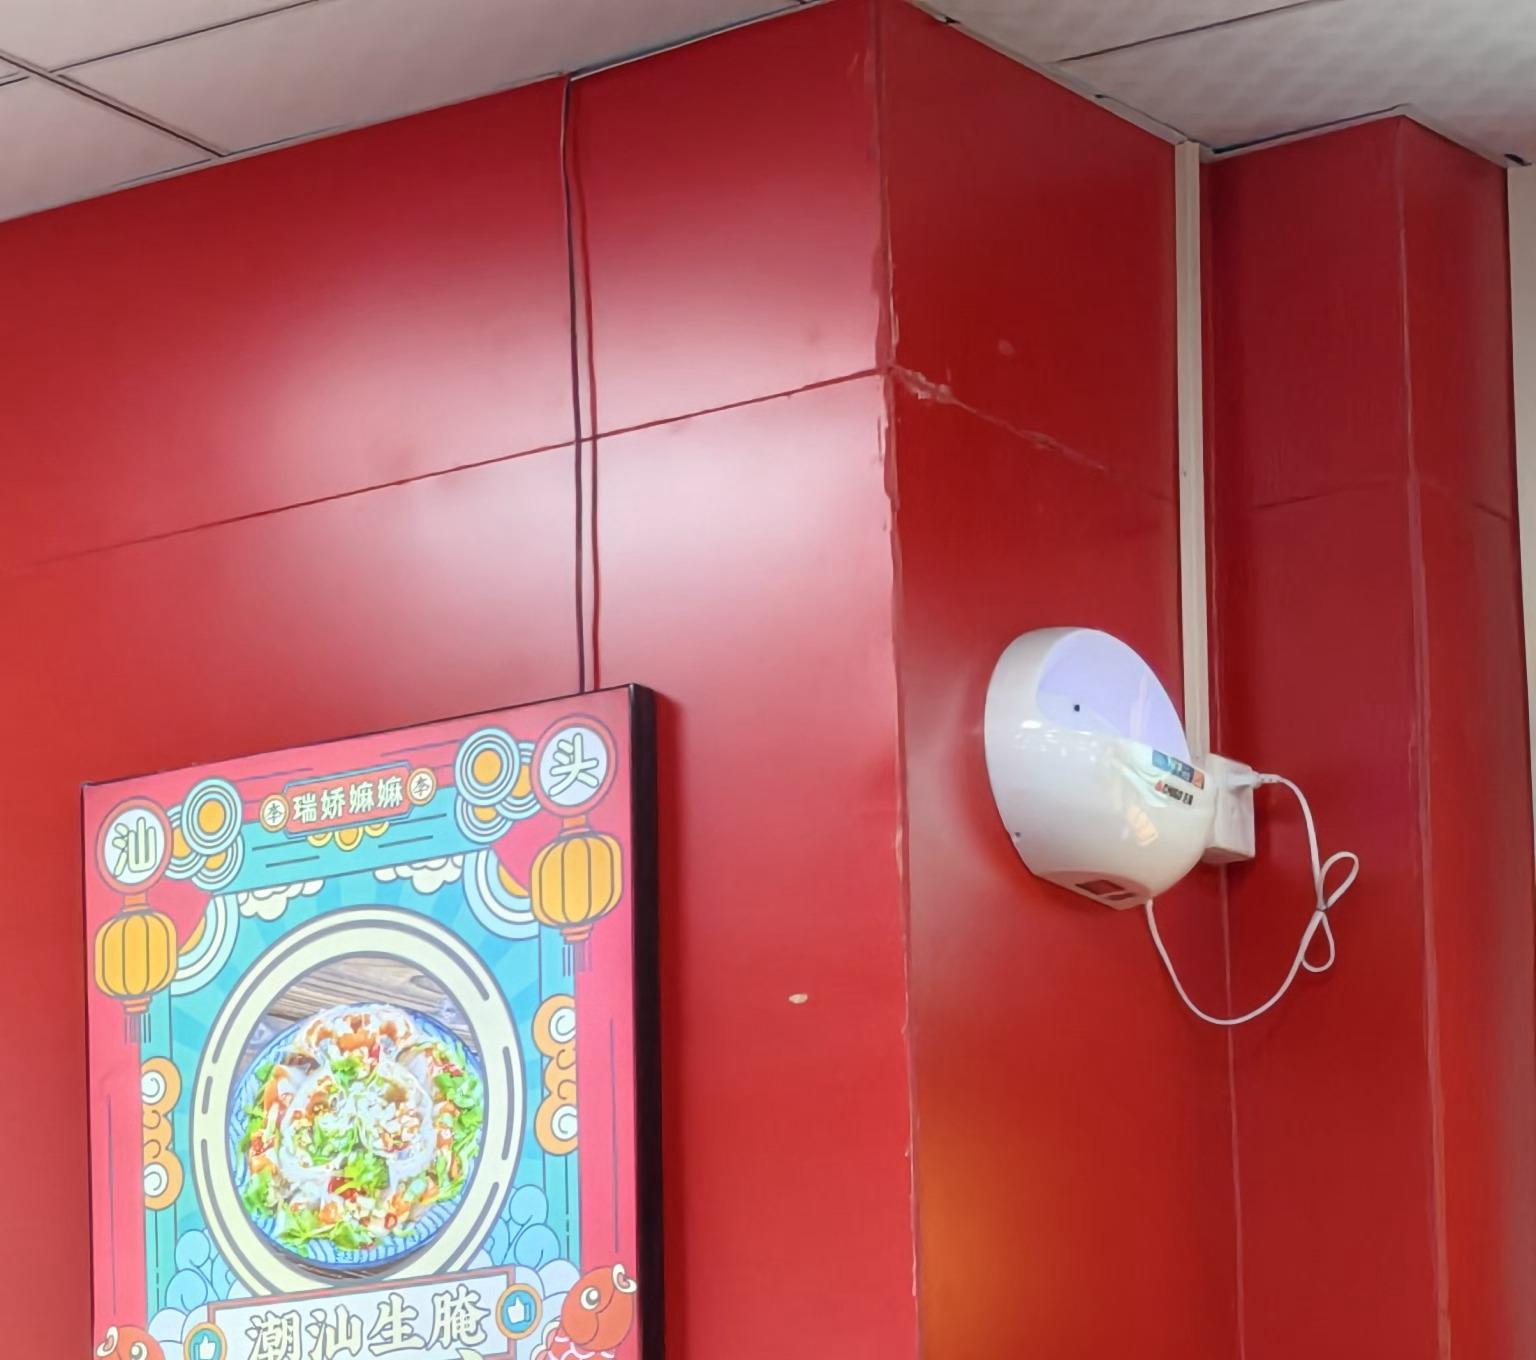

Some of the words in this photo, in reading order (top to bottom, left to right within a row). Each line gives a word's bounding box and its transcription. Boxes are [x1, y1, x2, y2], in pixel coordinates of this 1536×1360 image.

[113, 820, 158, 876] 汕
[549, 737, 602, 802] 头
[292, 775, 404, 824] 瑞娇嫲嫲
